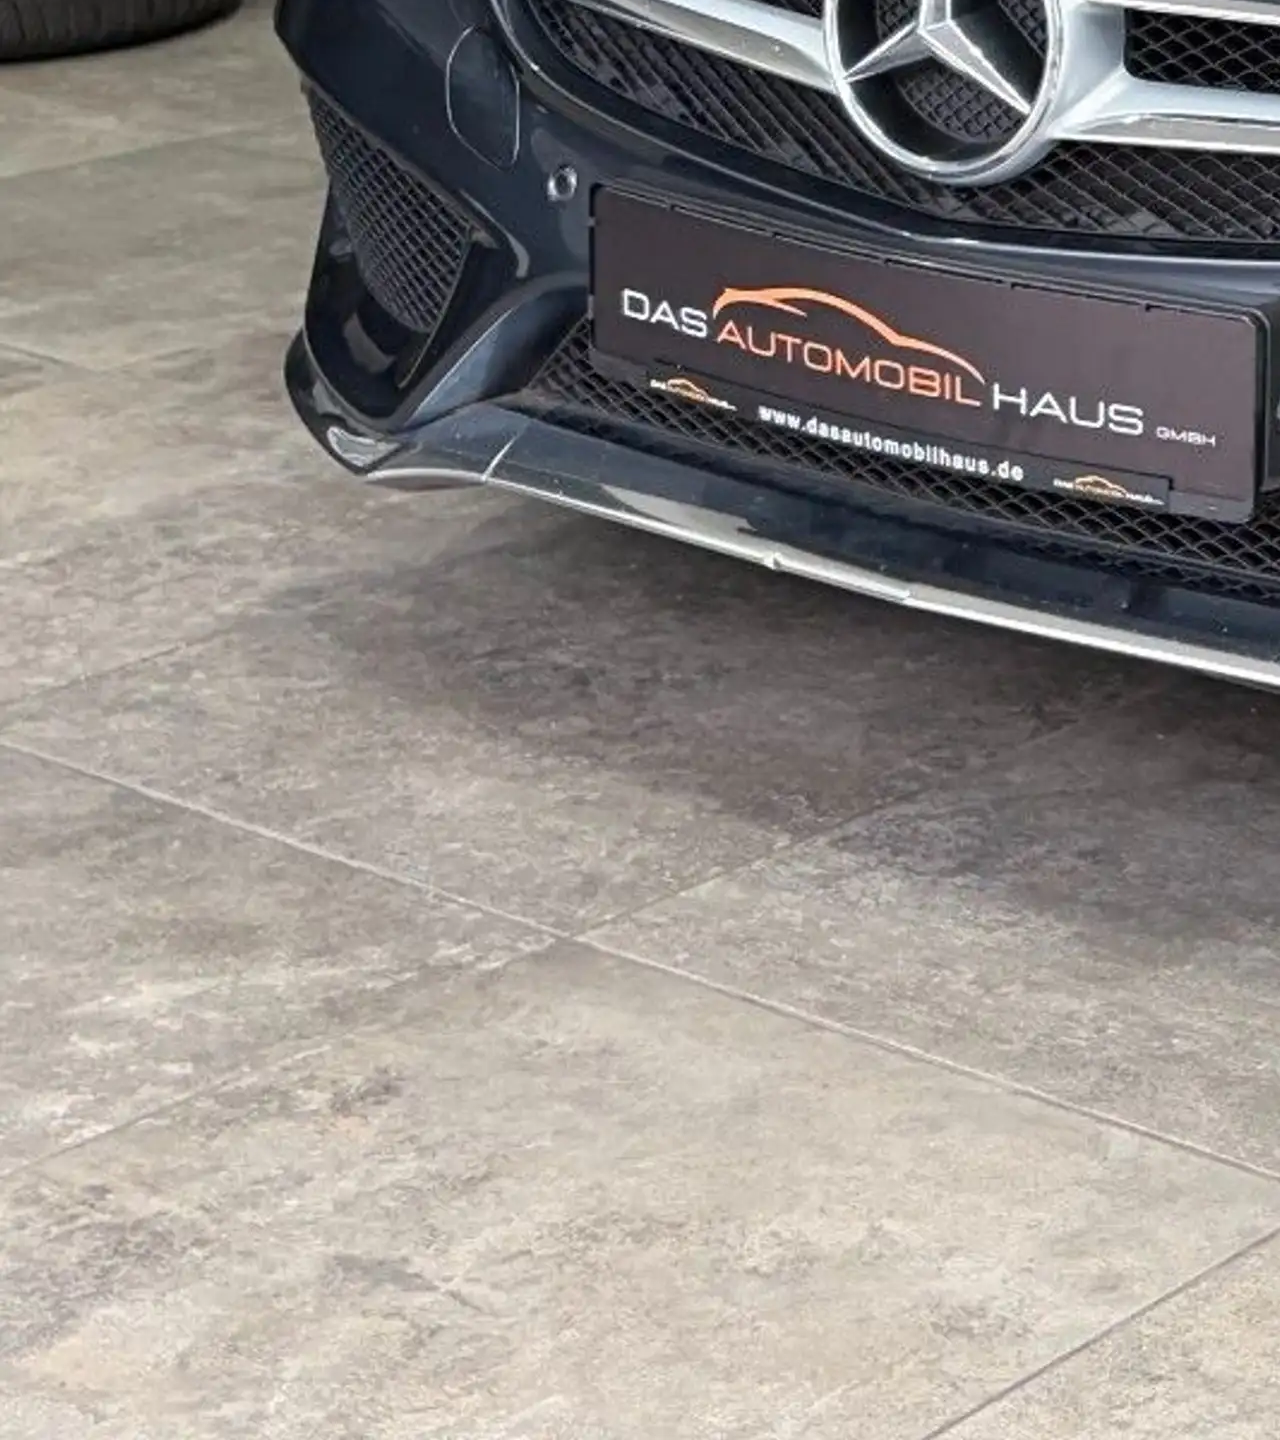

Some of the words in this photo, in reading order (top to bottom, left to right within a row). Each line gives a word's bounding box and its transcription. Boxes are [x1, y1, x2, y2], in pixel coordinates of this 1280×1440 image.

[623, 288, 708, 338] DAS
[717, 321, 982, 407] AUTOMOBIL
[992, 383, 1143, 436] HAUS
[758, 405, 1024, 481] www.dasautomobilhaus.de
